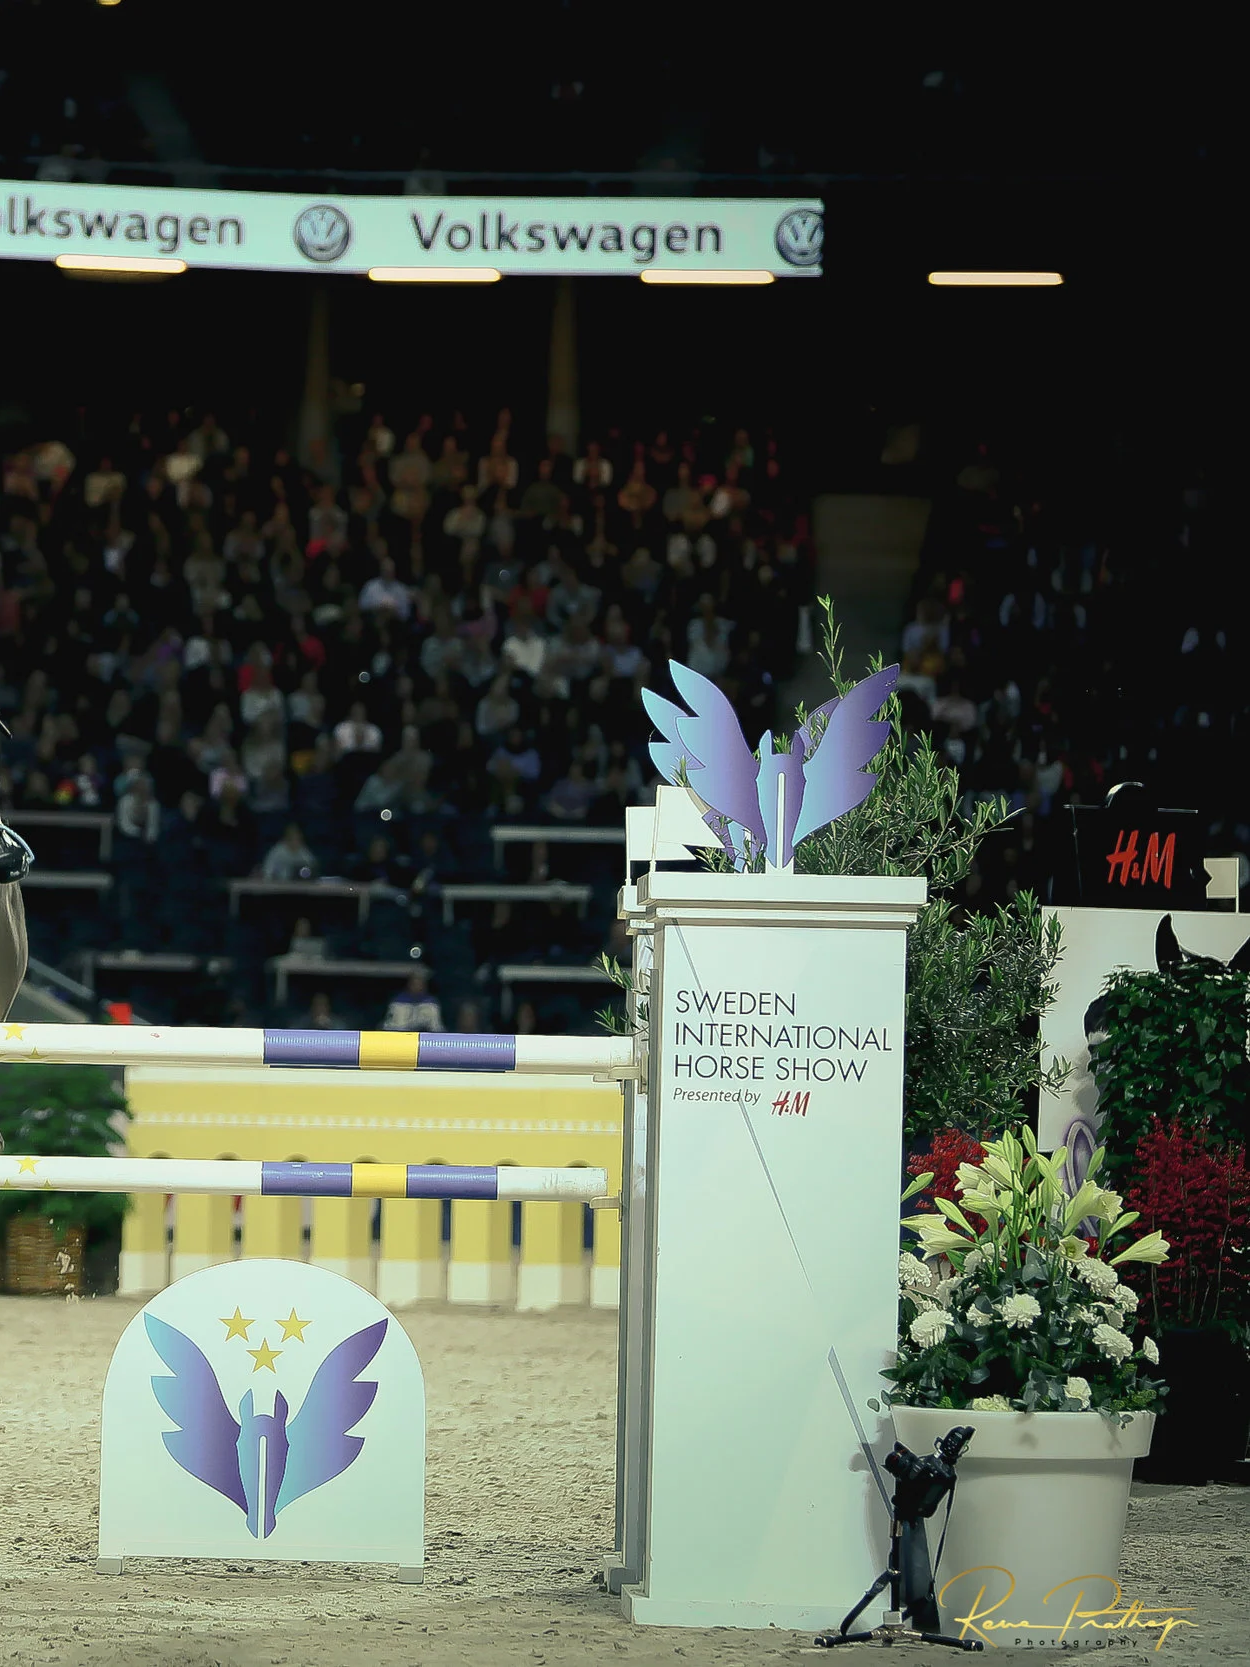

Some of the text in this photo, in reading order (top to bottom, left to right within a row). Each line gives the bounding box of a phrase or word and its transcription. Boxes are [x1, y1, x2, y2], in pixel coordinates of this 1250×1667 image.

[410, 210, 722, 262] Volkswagen
[1106, 829, 1176, 889] H&M
[675, 989, 796, 1017] SWEDEN
[675, 1022, 893, 1051] INTERNATIONAL
[674, 1054, 868, 1083] HORSE SHOW
[673, 1087, 811, 1117] Presented by H&M
